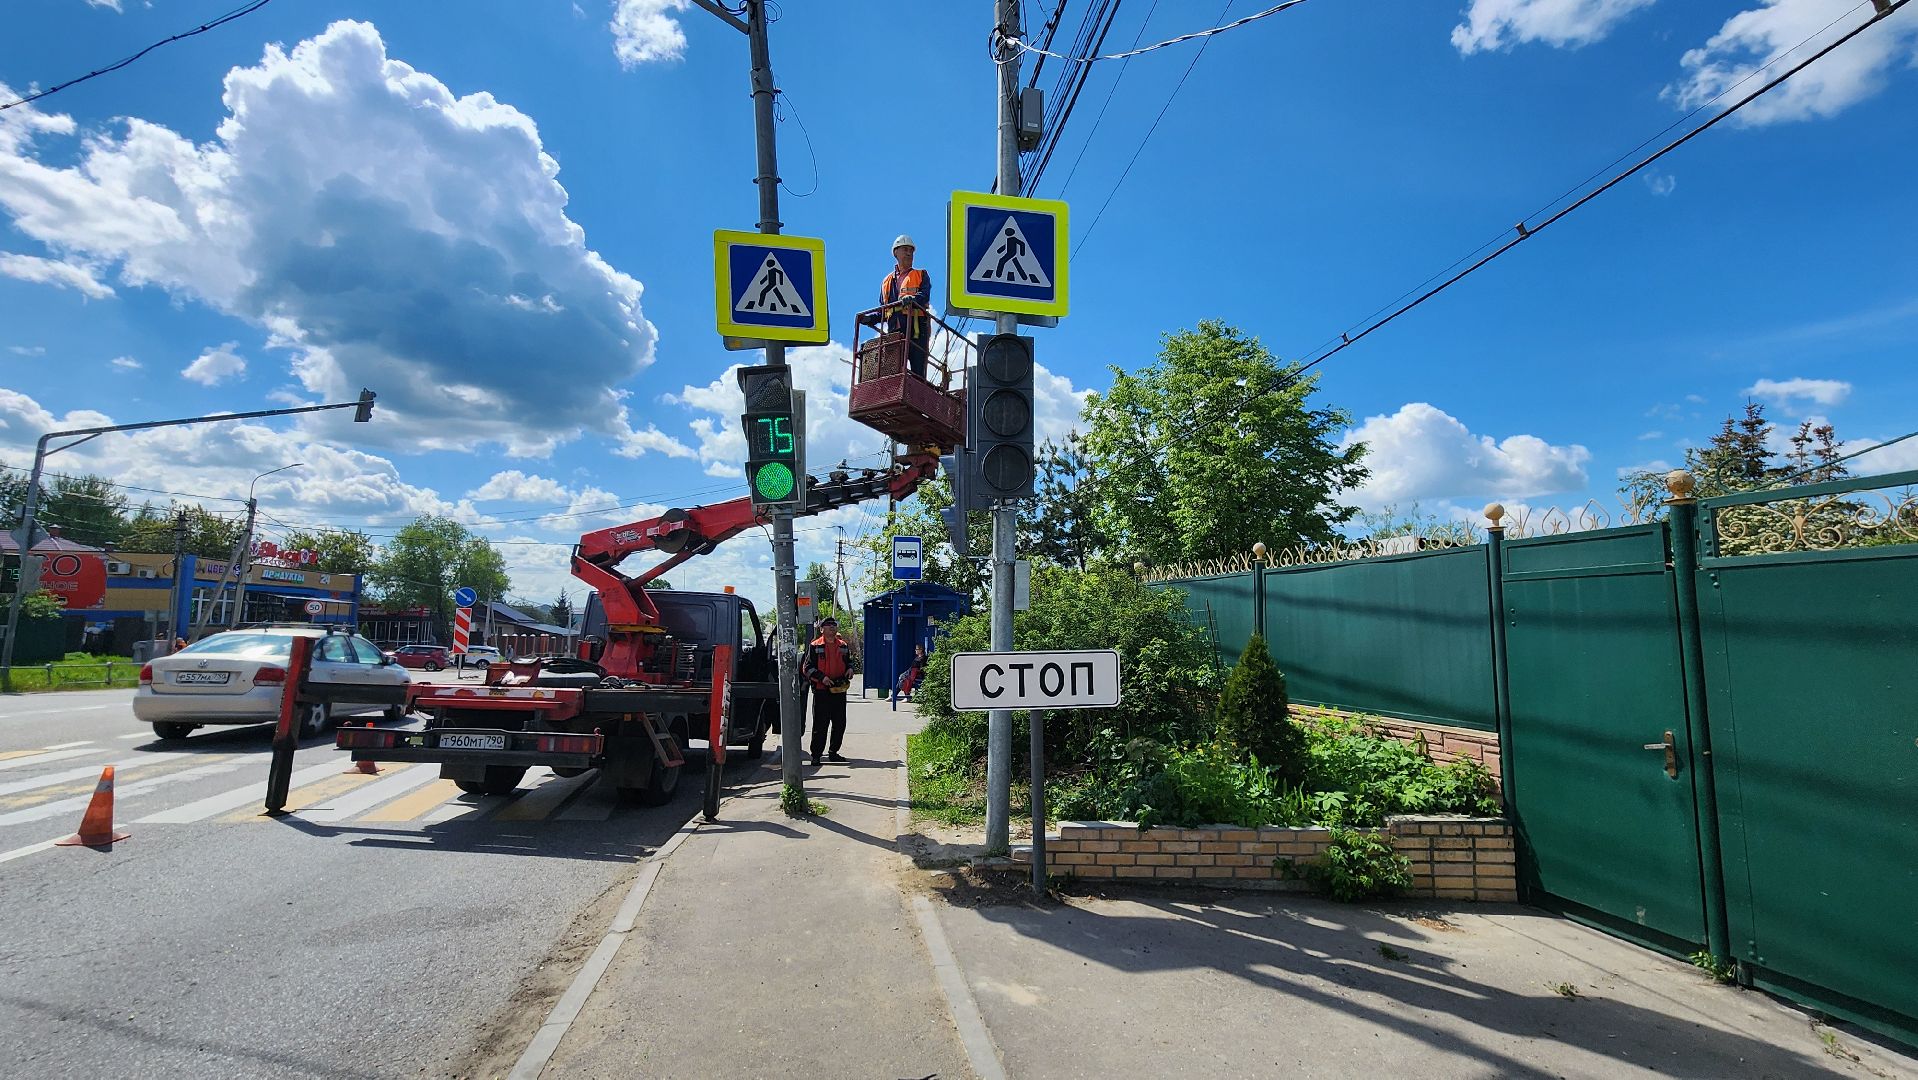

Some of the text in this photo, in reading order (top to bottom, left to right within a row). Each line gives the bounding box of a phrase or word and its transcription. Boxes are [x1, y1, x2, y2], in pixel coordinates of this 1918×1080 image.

[758, 416, 793, 453] 75
[979, 662, 1095, 698] СТОП
[443, 735, 503, 747] Т960МТ 790
